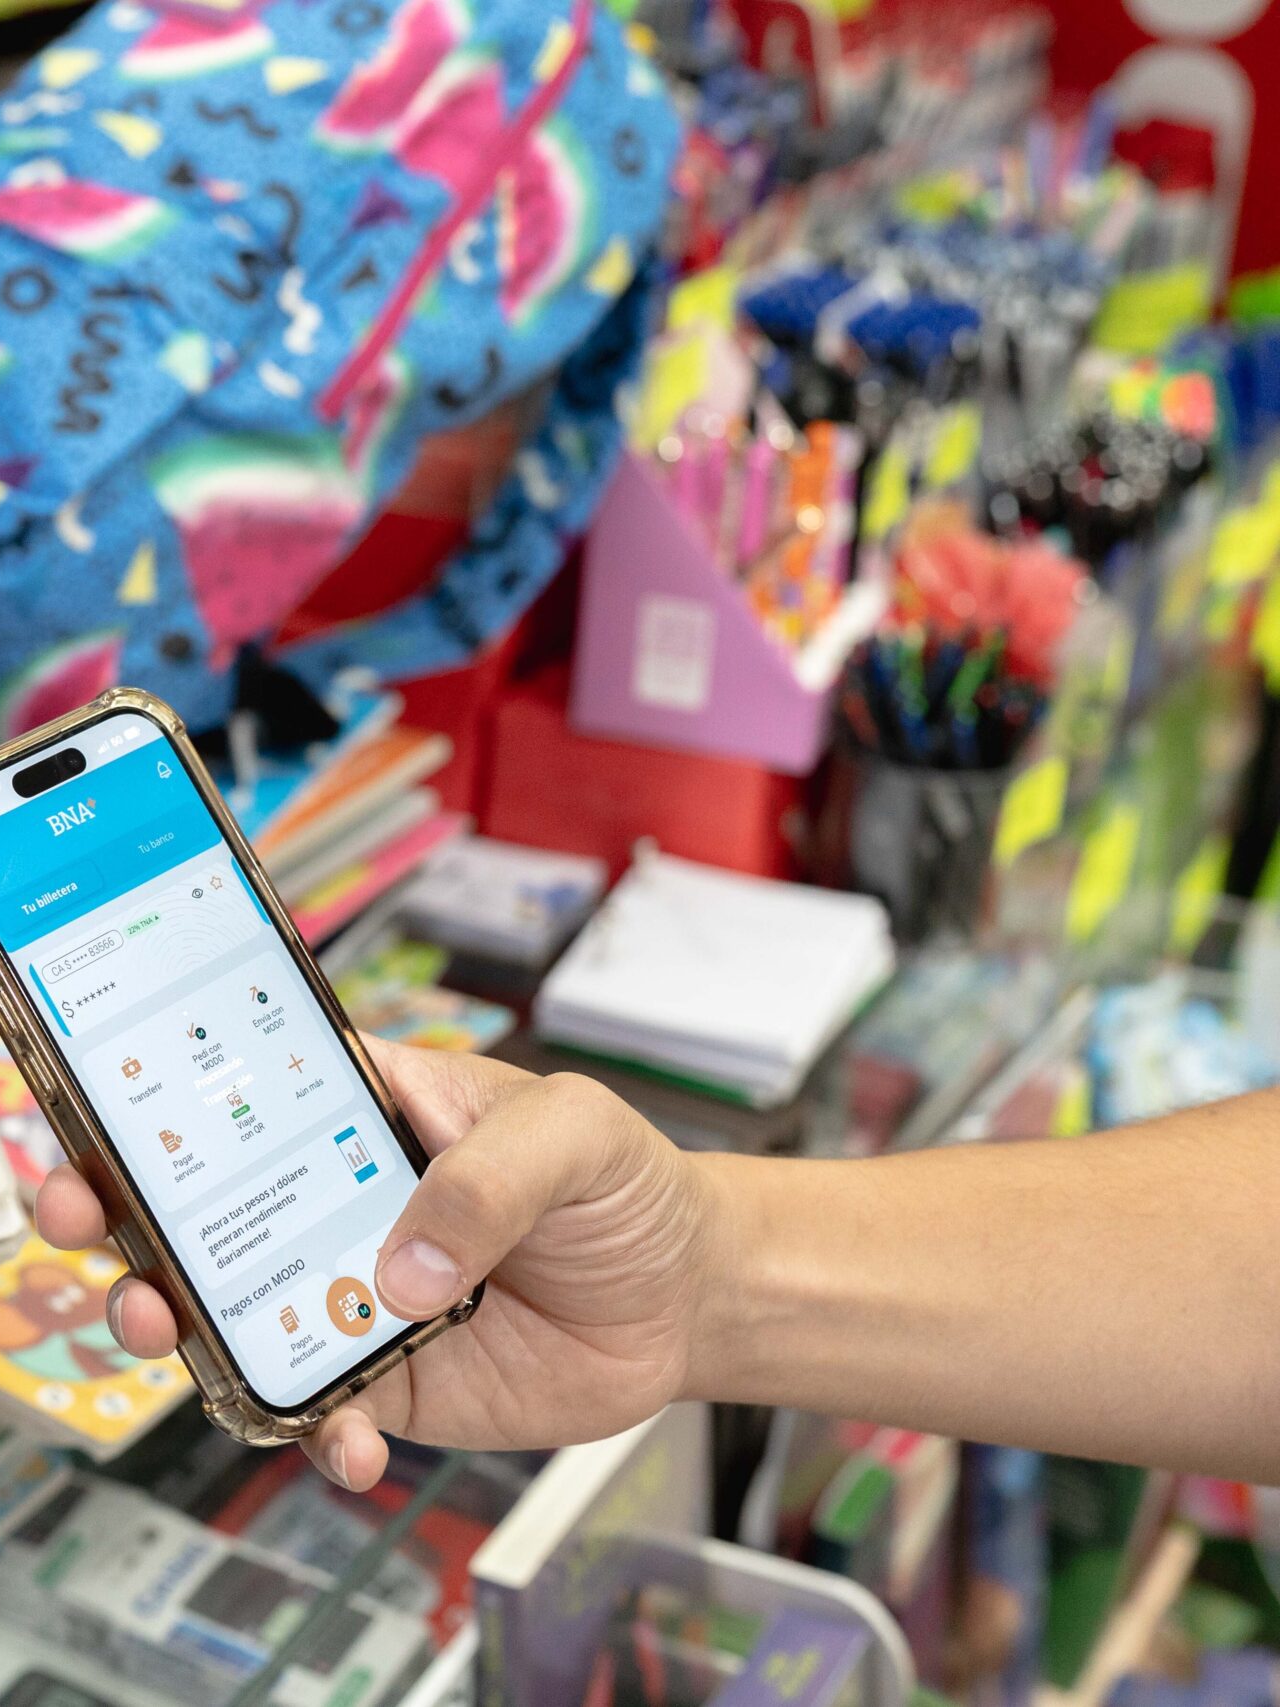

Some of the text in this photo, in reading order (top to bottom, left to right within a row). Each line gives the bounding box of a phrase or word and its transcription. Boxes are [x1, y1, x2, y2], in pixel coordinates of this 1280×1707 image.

[137, 832, 175, 854] Tu banco
[21, 881, 79, 916] Tu billetera
[51, 964, 66, 977] CA
[88, 937, 116, 957] 83566
[61, 1000, 75, 1019] $
[271, 1006, 285, 1018] con
[262, 1017, 285, 1036] MODO
[208, 1042, 223, 1055] con
[201, 1053, 225, 1072] MODO
[128, 1082, 163, 1106] Transferir
[295, 1077, 324, 1100] Aún más
[235, 1114, 257, 1130] Viajar
[240, 1122, 266, 1142] con QR
[172, 1152, 195, 1169] Pagar
[174, 1160, 206, 1183] servicios
[199, 1164, 309, 1242] ¡Ahora tus pesos y dólares
[208, 1192, 297, 1257] generan rendimiento
[216, 1227, 272, 1270] diariamente!
[220, 1258, 306, 1321] Pagos con MODO
[289, 1339, 328, 1369] efectuados
[290, 1333, 314, 1353] Pagos
